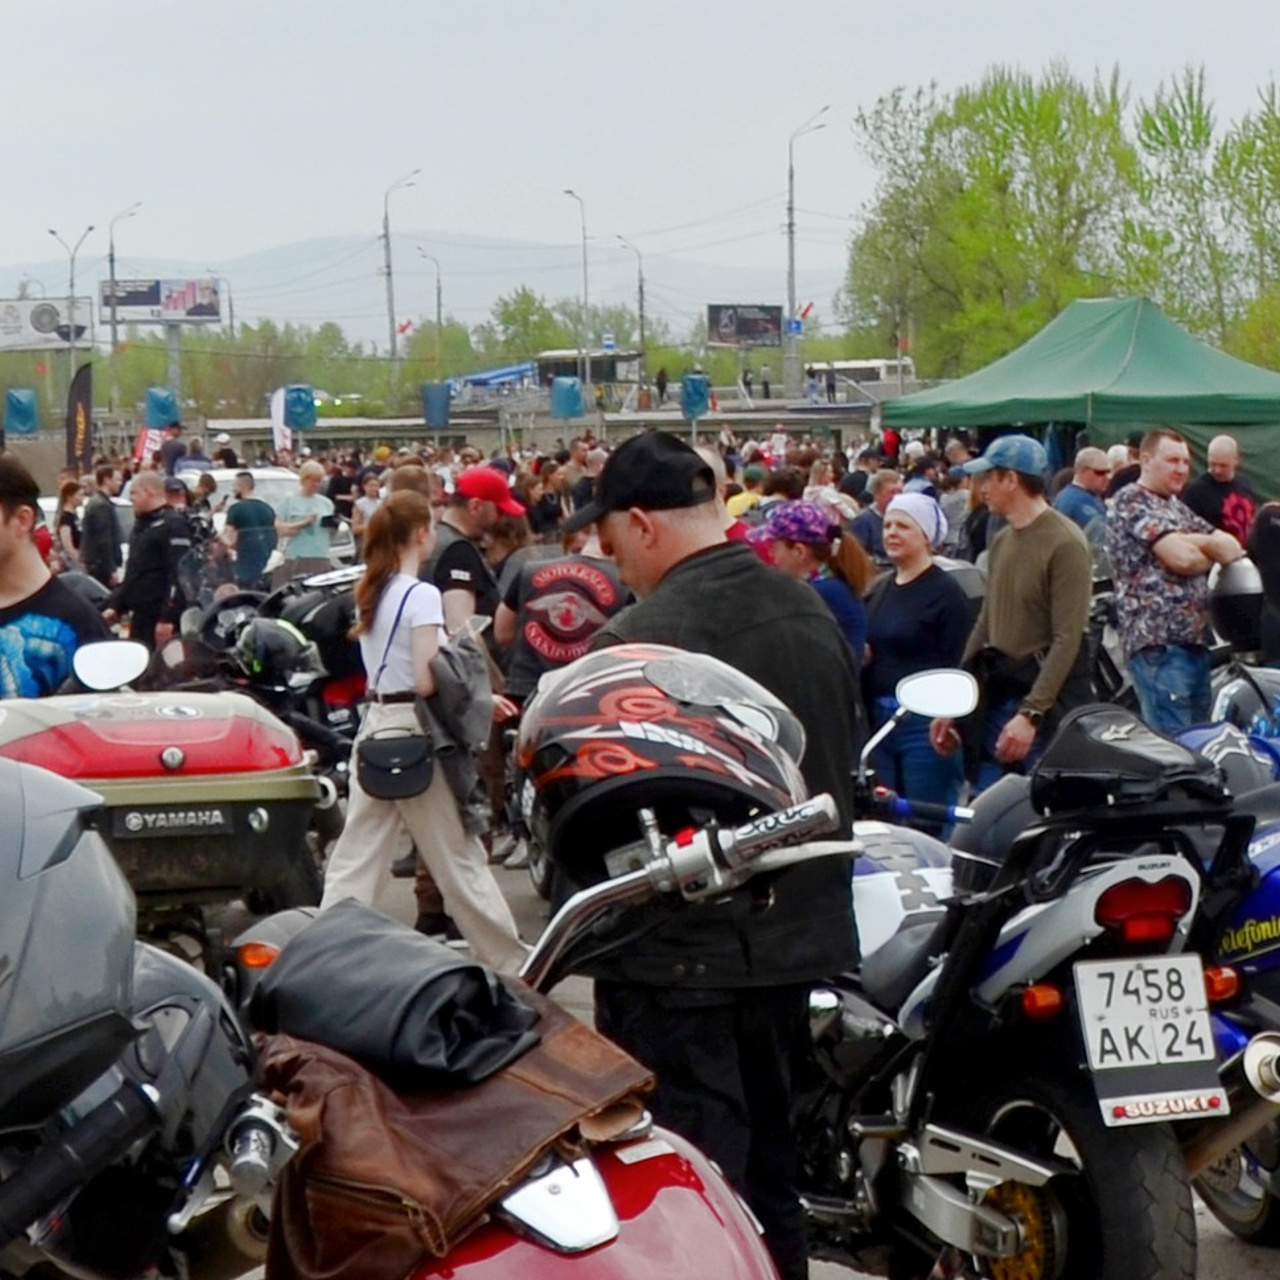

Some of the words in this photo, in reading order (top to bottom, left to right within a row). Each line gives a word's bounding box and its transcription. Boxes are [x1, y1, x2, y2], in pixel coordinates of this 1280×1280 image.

[143, 808, 225, 829] YAMAHA
[1137, 860, 1172, 871] SUZUKI
[1097, 967, 1186, 1009] 7458
[1149, 1006, 1181, 1020] RUS
[1098, 1024, 1151, 1065] AK
[1161, 1019, 1206, 1059] 24
[1123, 1097, 1209, 1119] SUZUKI
